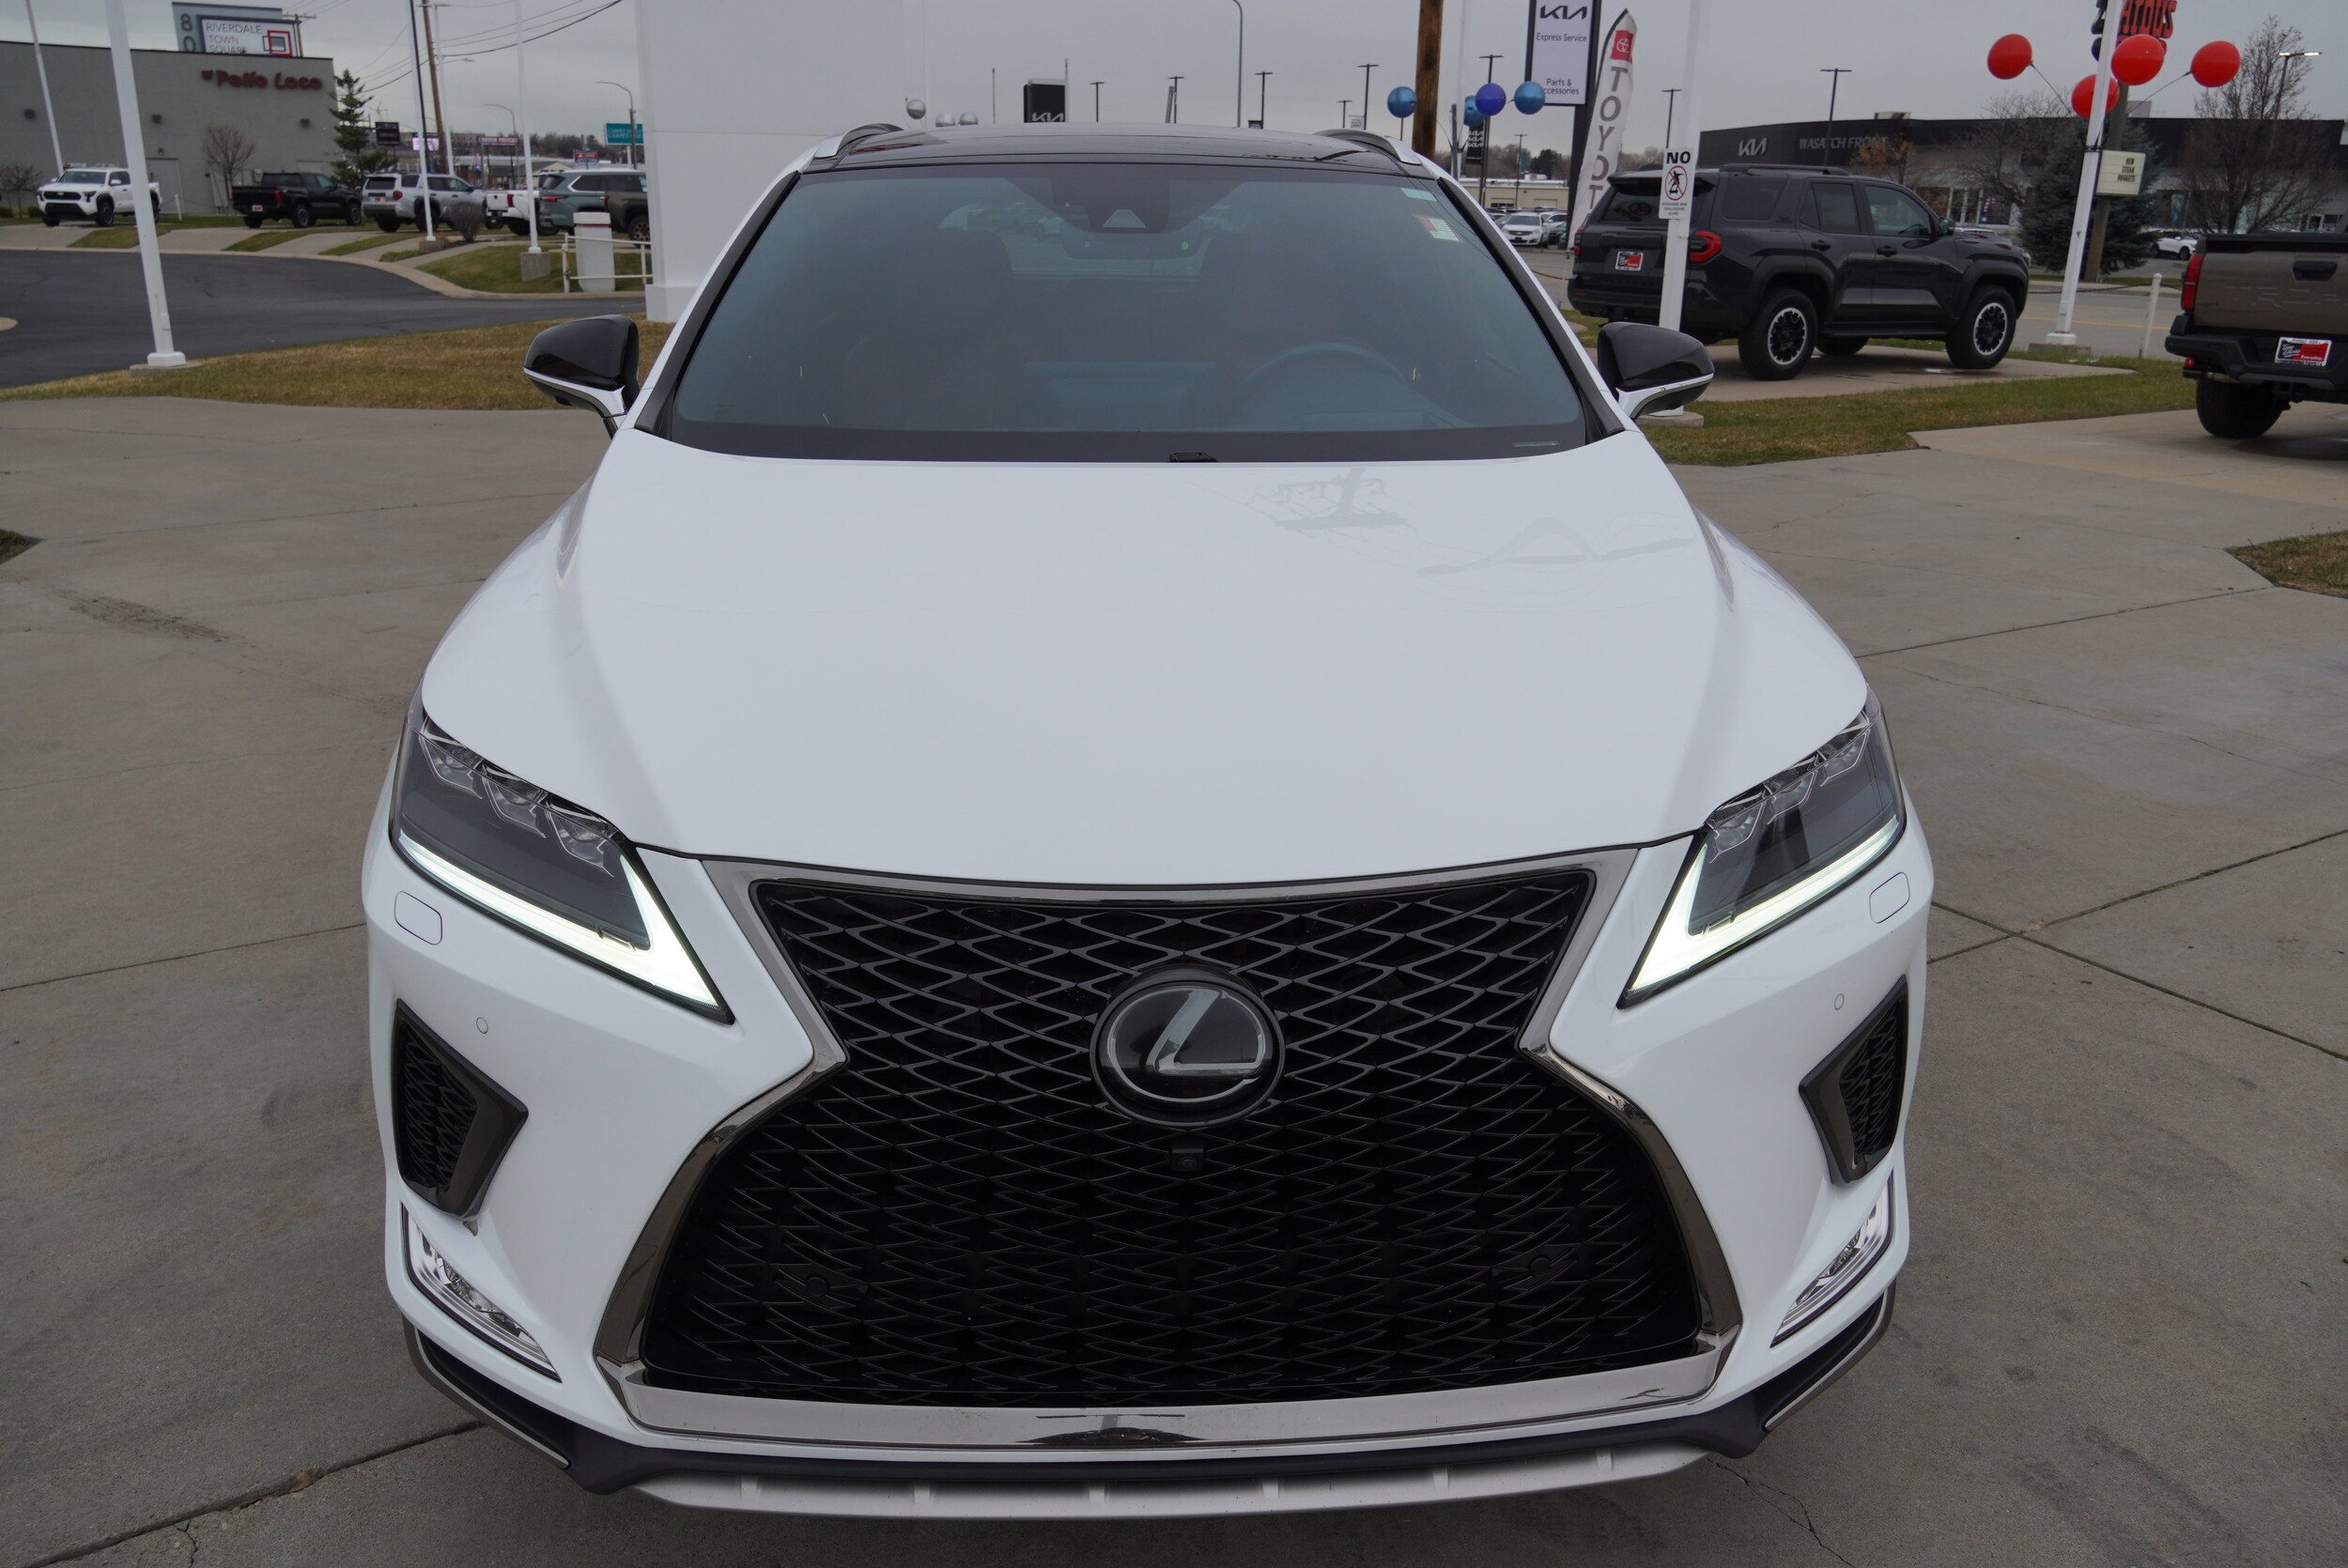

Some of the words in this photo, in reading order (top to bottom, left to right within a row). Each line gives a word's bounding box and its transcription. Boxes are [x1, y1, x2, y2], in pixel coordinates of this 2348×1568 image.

[1539, 5, 1587, 20] KIA
[206, 23, 263, 34] RIVERDALE
[208, 35, 239, 44] TOWN
[1536, 32, 1562, 42] Express
[1564, 34, 1587, 42] Service
[274, 71, 323, 90] Loco
[1546, 78, 1566, 86] Parts
[1543, 86, 1580, 95] ccessories
[1738, 138, 1768, 157] KIA
[1666, 151, 1691, 164] NO
